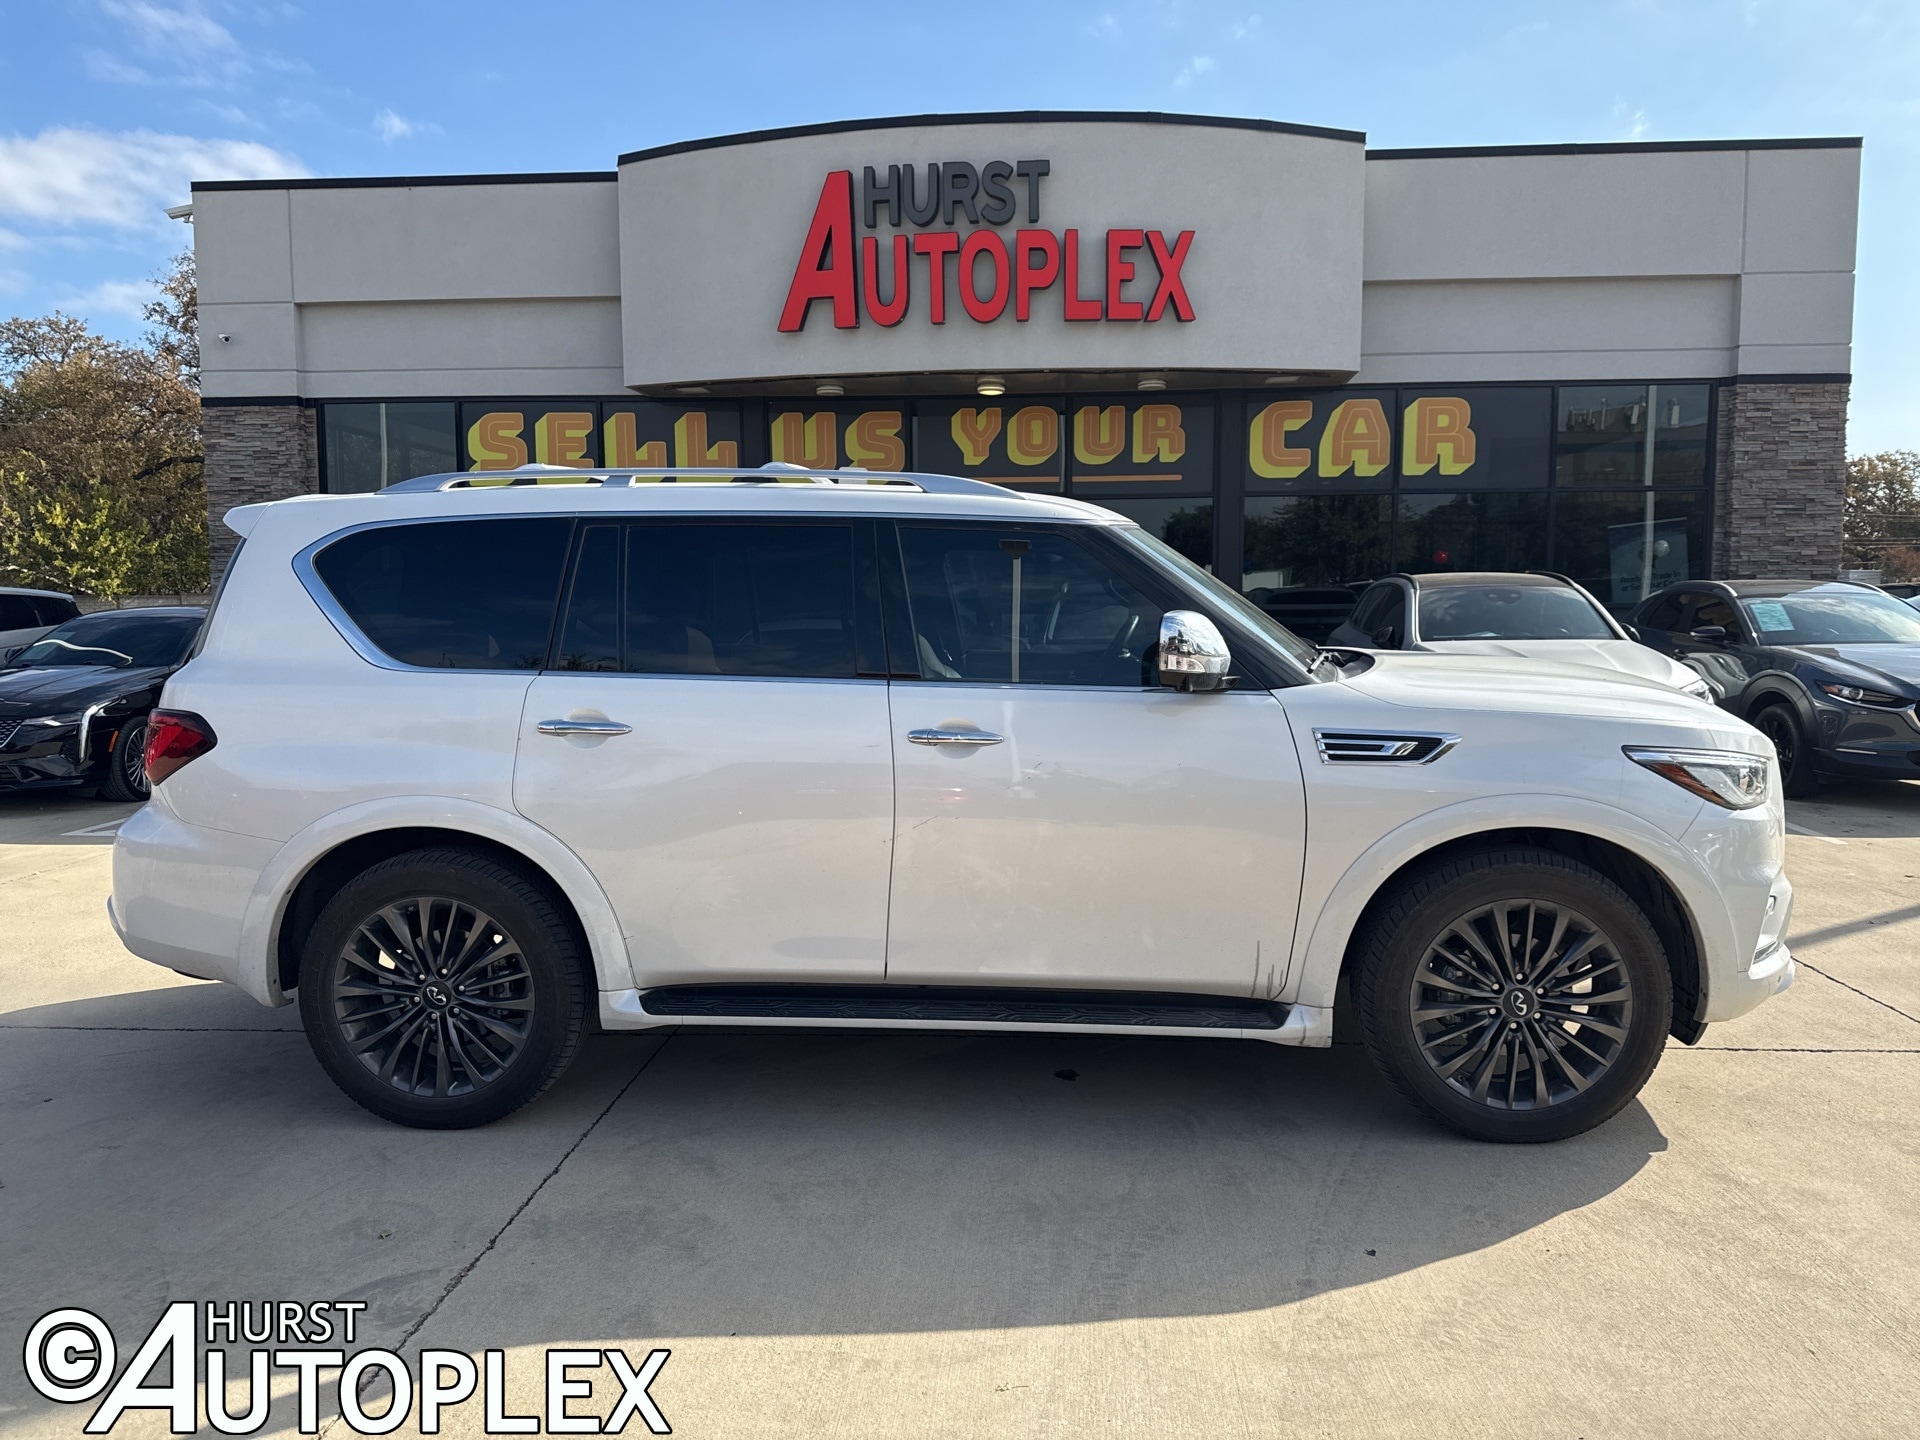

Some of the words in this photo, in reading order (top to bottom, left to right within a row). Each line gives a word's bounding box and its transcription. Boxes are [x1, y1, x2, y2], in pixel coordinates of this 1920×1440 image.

[863, 159, 1051, 228] HURST
[777, 169, 1196, 333] AUTOPLEX
[467, 411, 738, 486] SELL
[770, 410, 906, 486] US
[951, 404, 1186, 466] YOUR
[1249, 397, 1477, 479] CAR
